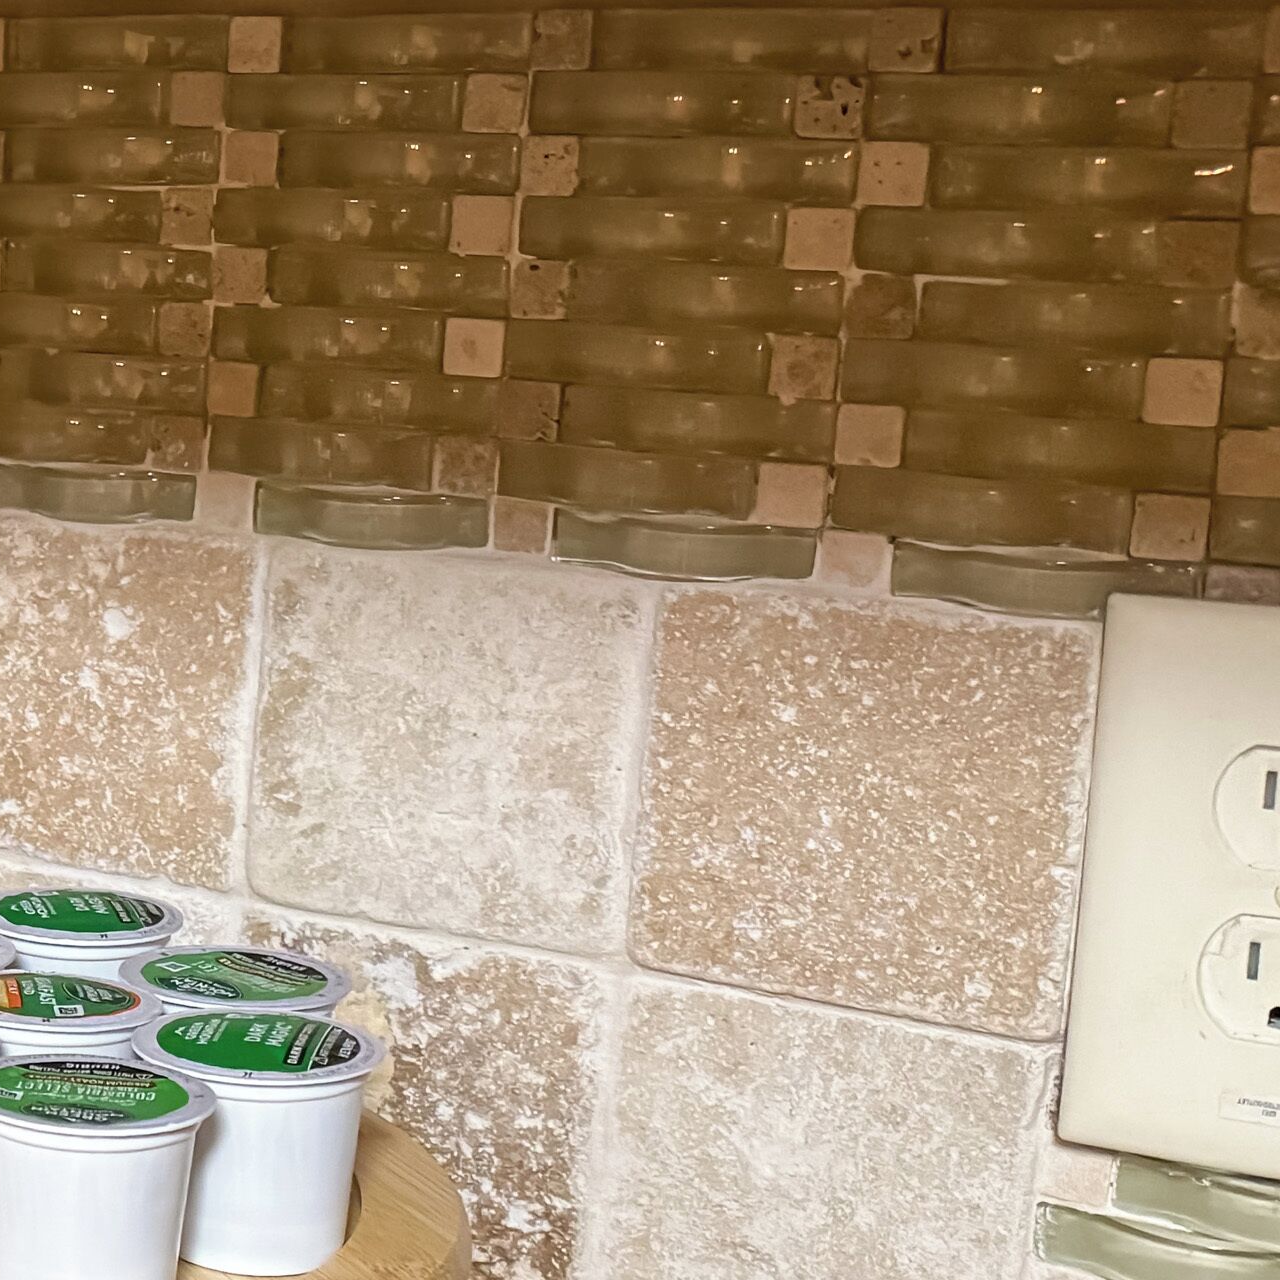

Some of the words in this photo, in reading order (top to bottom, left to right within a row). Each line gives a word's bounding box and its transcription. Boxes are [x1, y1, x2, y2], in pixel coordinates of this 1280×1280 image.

[244, 1023, 269, 1043] DARK
[265, 1021, 292, 1047] MAGIC
[15, 1081, 71, 1094] SELECT
